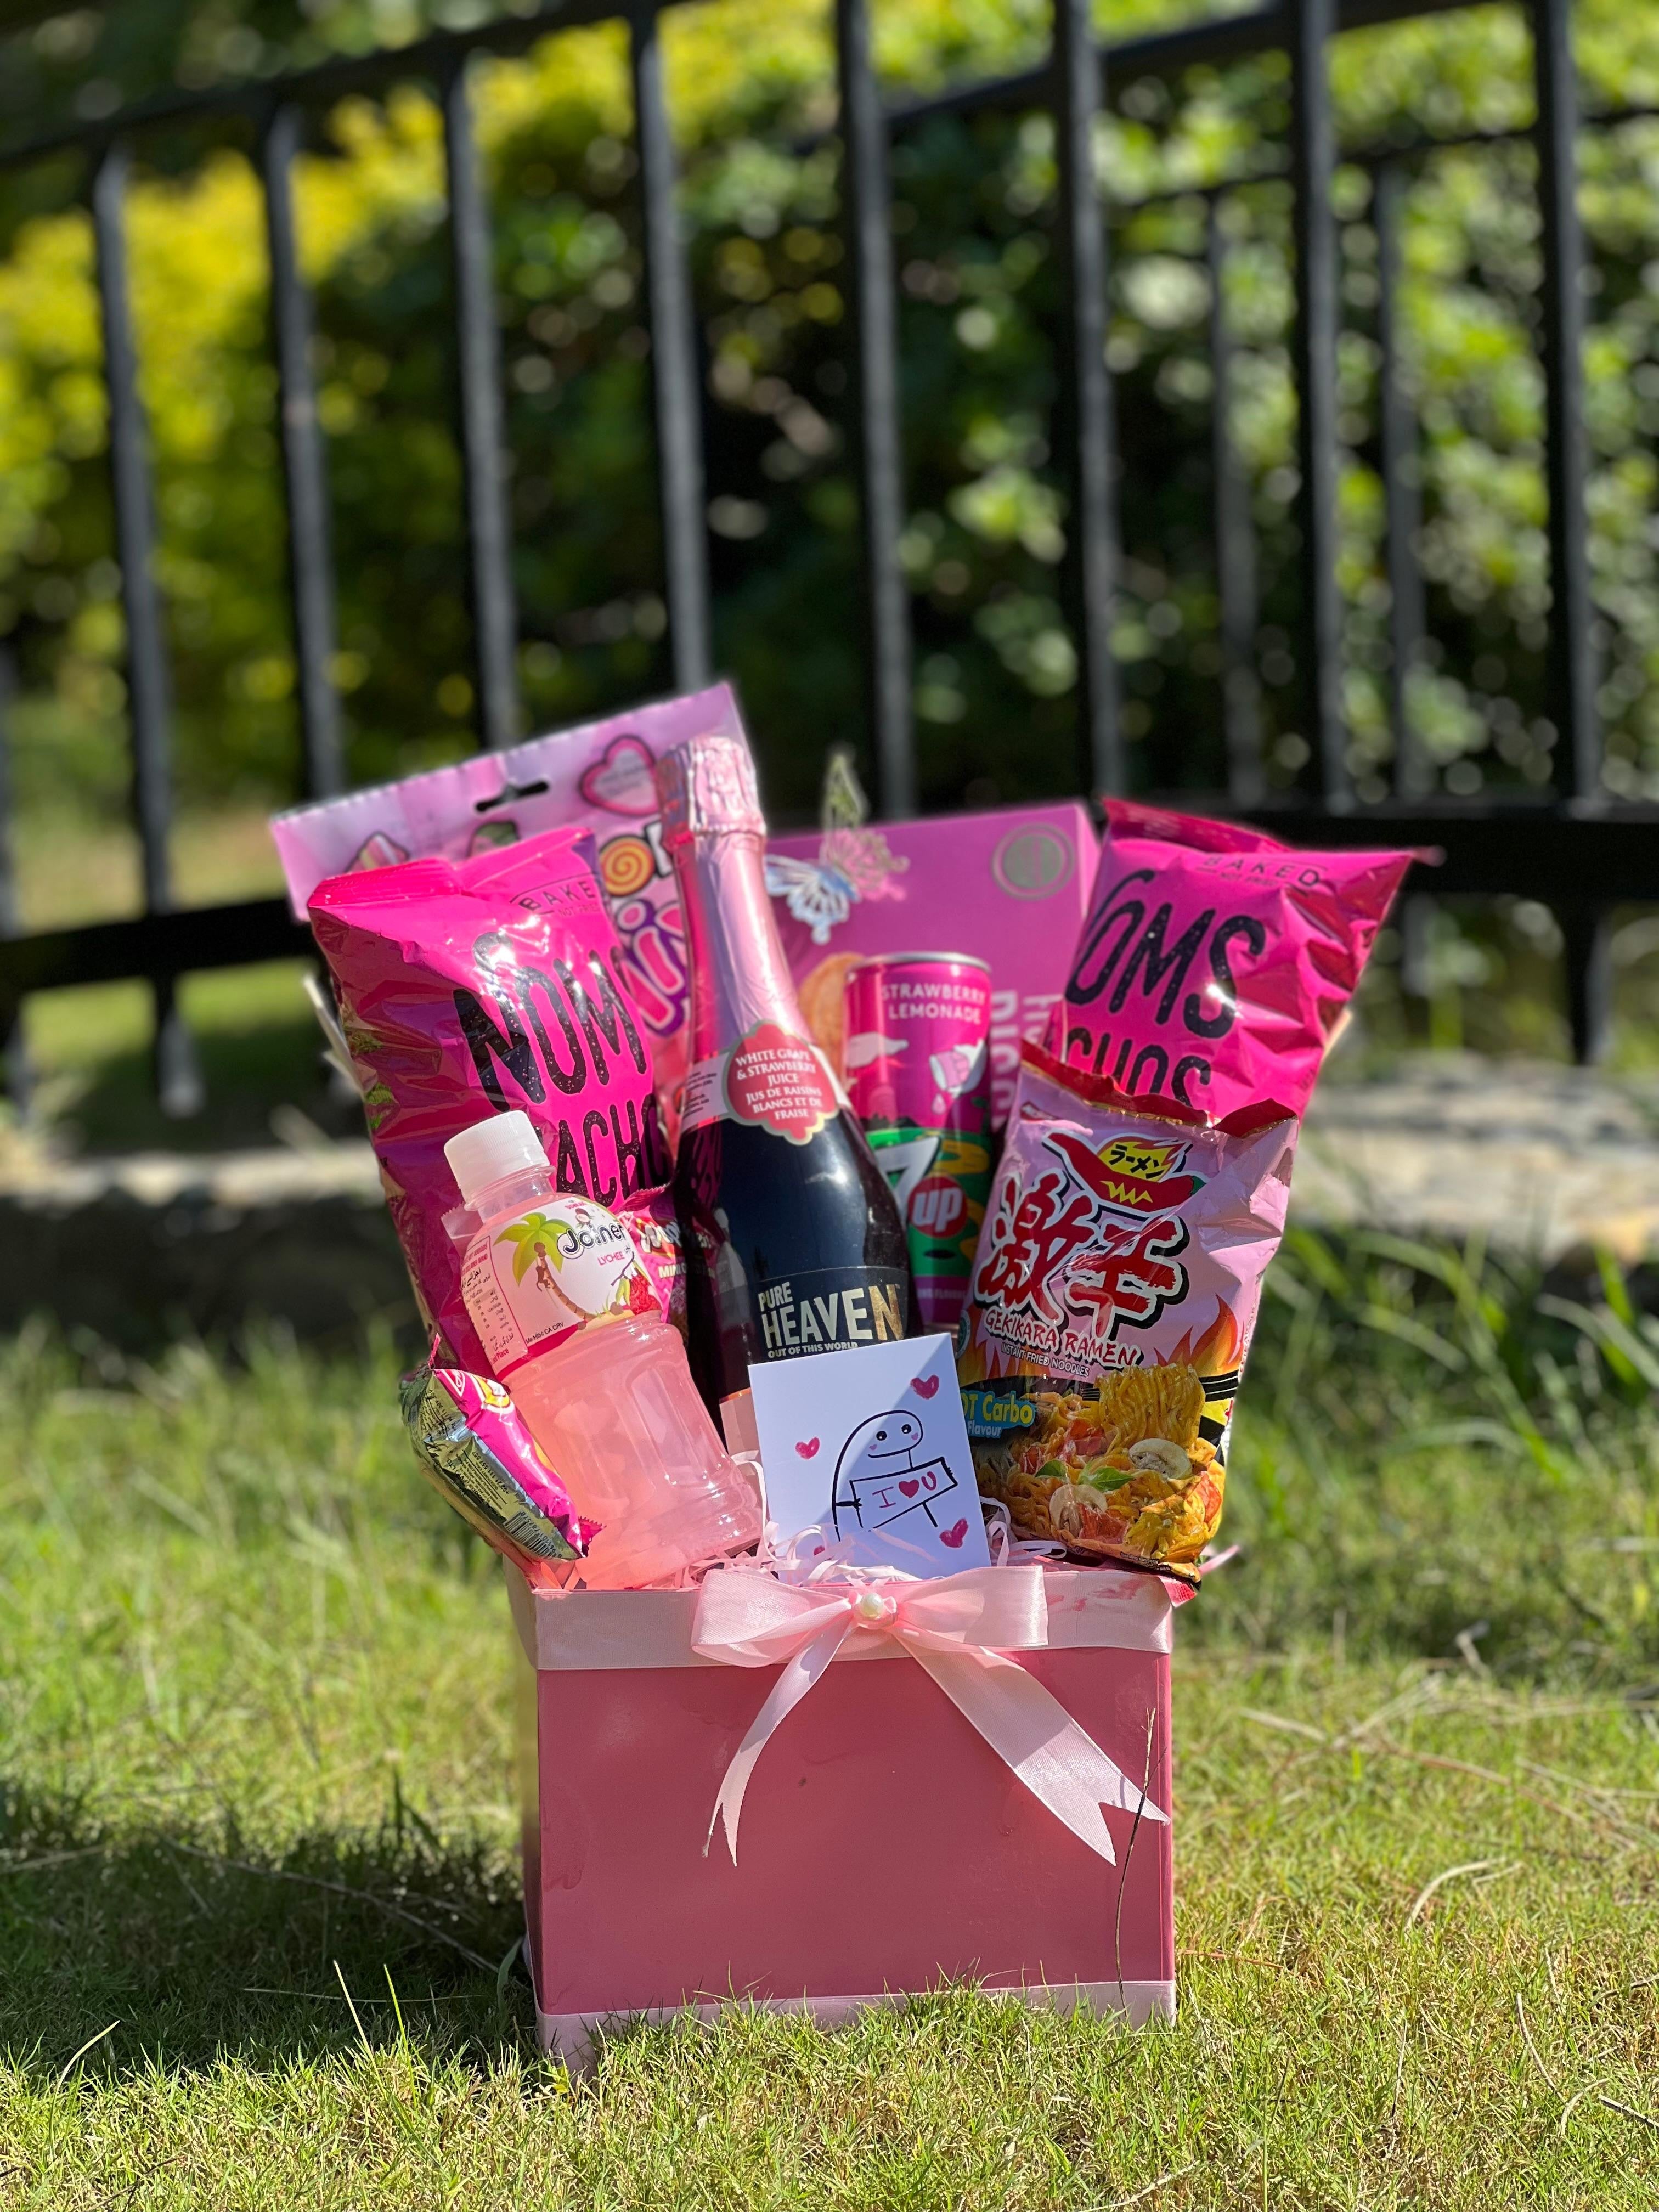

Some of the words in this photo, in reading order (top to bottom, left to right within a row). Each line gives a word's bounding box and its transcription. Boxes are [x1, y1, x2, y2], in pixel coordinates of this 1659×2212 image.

[1065, 869, 1266, 1039] OMS
[453, 932, 647, 1111] NOM
[888, 1003, 981, 1024] LEMONADE
[735, 1050, 776, 1066] WHITE
[737, 1070, 747, 1080] &
[747, 1061, 816, 1076] STRAWBERRY
[768, 1074, 799, 1087] JUICE
[746, 1090, 765, 1105] JUS
[767, 1088, 781, 1097] DE
[785, 1086, 822, 1096] RAISINS
[753, 1098, 793, 1113] BLANCS
[795, 1098, 806, 1107] ET
[774, 1109, 809, 1120] FRAISE
[1108, 1144, 1165, 1180] ラーメン
[872, 1136, 940, 1232] 7
[597, 1251, 625, 1266] LYCHEE
[975, 1172, 1185, 1340] 激辛
[658, 1264, 681, 1278] MINI
[758, 1282, 793, 1312] PURE
[761, 1284, 905, 1349] HEAVEN
[985, 1308, 1057, 1349] GEKIKARA
[1065, 1331, 1138, 1367] RAMEN
[768, 1348, 787, 1358] OUT
[788, 1346, 802, 1355] OF
[802, 1343, 823, 1353] THIS
[823, 1341, 859, 1351] WORLD
[1001, 1342, 1026, 1361] INSTANT
[1026, 1352, 1050, 1365] FRIED
[1051, 1359, 1090, 1378] NOODLES
[964, 1393, 978, 1419] OT
[983, 1394, 1032, 1424] Carbo
[967, 1420, 1002, 1437] Flavour
[487, 1468, 496, 1479] 111
[872, 1486, 896, 1508] I
[921, 1471, 937, 1491] U
